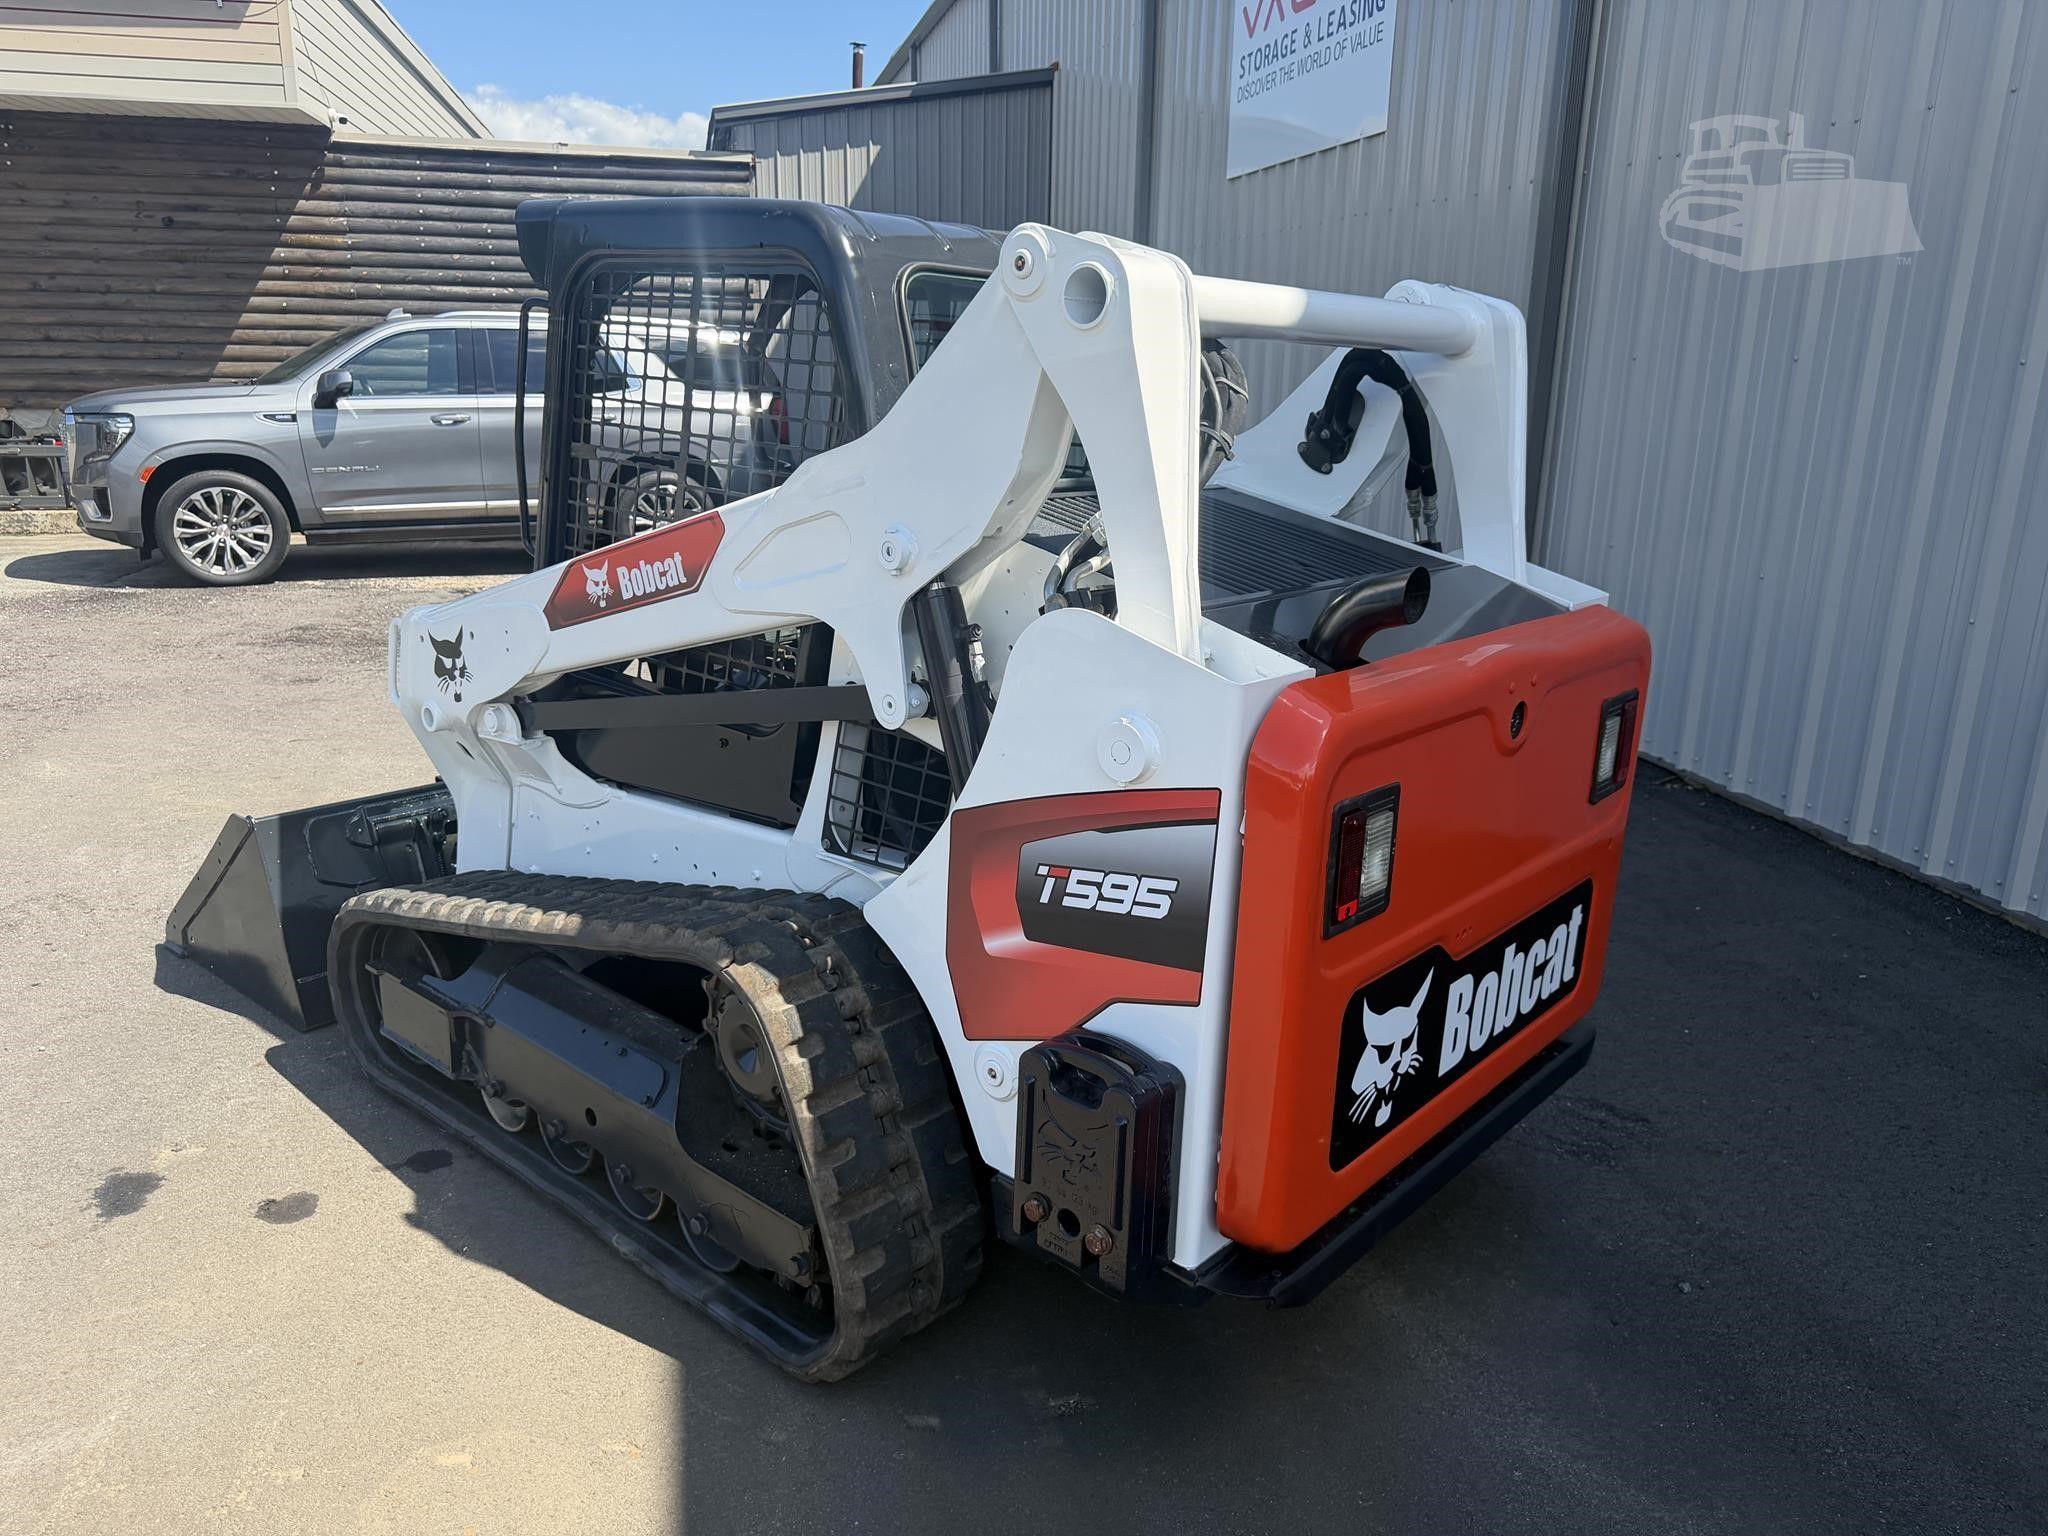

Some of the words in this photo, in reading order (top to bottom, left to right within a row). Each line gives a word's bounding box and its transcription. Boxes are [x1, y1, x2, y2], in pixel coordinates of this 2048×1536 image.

[1237, 71, 1277, 104] DISCOVER
[1279, 61, 1295, 85] THE
[1297, 46, 1332, 77] WORLD
[1334, 37, 1348, 61] OF
[1351, 21, 1384, 53] VALUE
[1240, 28, 1298, 79] STORAGE
[1303, 22, 1312, 49] &
[616, 551, 687, 600] Bobcat
[1037, 865, 1179, 920] T595
[1438, 904, 1583, 1077] Bobcat
